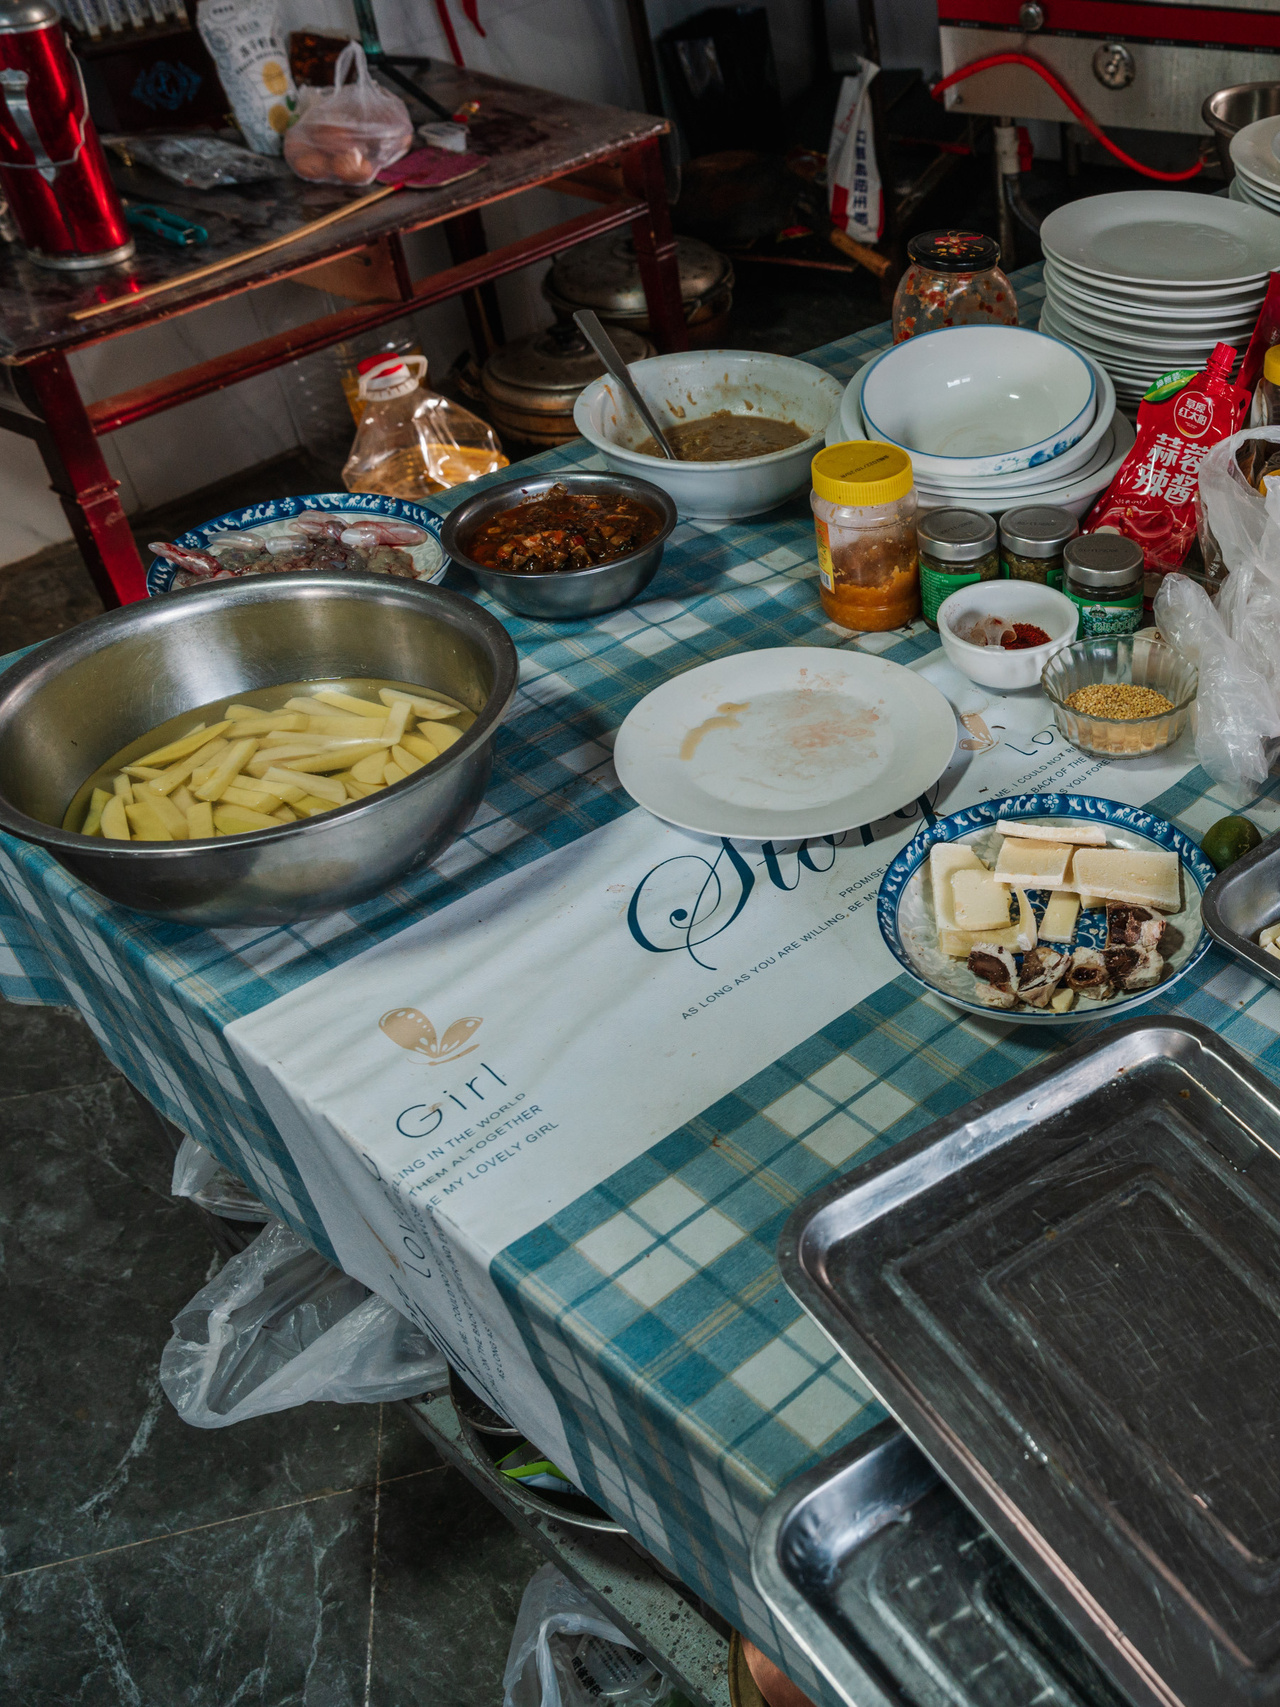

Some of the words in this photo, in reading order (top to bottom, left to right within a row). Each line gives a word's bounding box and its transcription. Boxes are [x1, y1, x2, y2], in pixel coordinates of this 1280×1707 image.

[1177, 406, 1209, 426] 红太阳
[1186, 397, 1205, 414] 草原
[1147, 432, 1210, 475] 蒜蓉
[1131, 462, 1199, 506] 辣酱
[1017, 765, 1048, 784] COULD
[1046, 752, 1066, 766] NOT
[1030, 775, 1057, 794] BACK
[1055, 767, 1068, 778] OF
[1067, 756, 1087, 769] THE
[1066, 775, 1087, 789] YOU
[838, 867, 886, 898] PROMISE
[681, 1006, 699, 1020] AS
[699, 984, 733, 1008] LONG
[734, 973, 751, 986] AS
[750, 956, 777, 974] YOU
[777, 940, 802, 959] ARE
[847, 900, 864, 912] BE
[863, 889, 879, 902] MY
[396, 1062, 507, 1138] Girl
[427, 1147, 445, 1160] IN
[445, 1128, 476, 1148] THE
[476, 1092, 526, 1129] WORLD
[408, 1168, 449, 1198] THEM
[451, 1104, 543, 1167] ALTOGETHER
[442, 1177, 465, 1196] MY
[467, 1141, 522, 1180] LOVELY
[525, 1121, 560, 1144] GIRL
